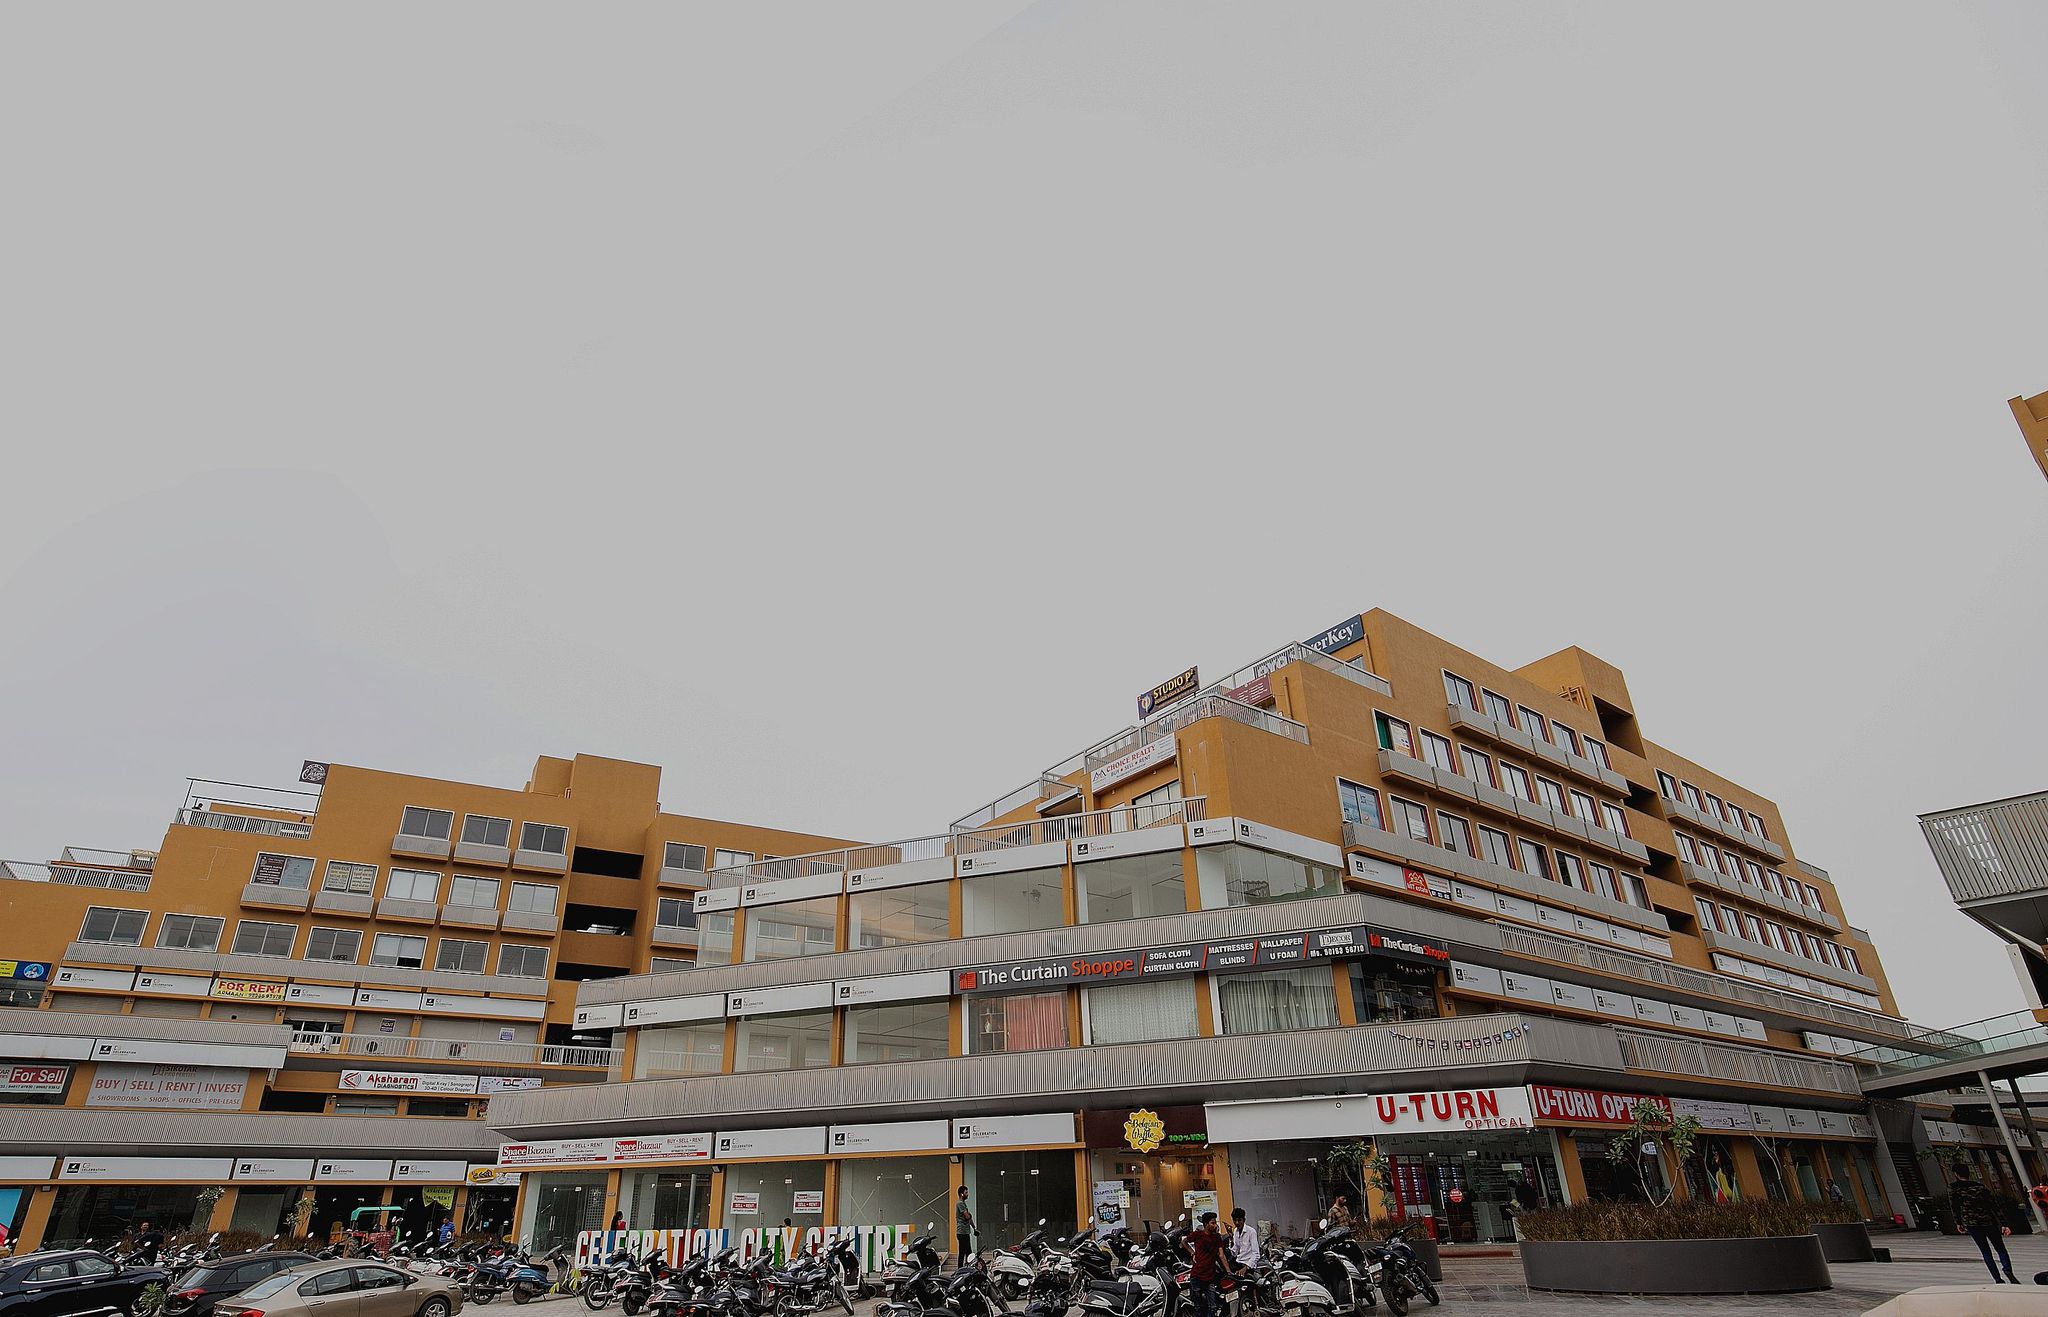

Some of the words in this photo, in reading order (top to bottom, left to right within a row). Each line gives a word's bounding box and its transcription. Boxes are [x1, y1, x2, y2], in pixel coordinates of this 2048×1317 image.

[1153, 674, 1184, 699] STUDIO
[1106, 758, 1131, 773] CHOICE
[1131, 745, 1156, 762] REALTY
[1208, 942, 1254, 954] MATTRESSES
[1260, 937, 1303, 949] WALLPAPER
[1381, 936, 1397, 949] The
[1397, 940, 1424, 955] Curtain
[1149, 952, 1168, 961] SOFA
[1169, 949, 1191, 959] CLOTH
[1220, 956, 1246, 966] BLINDS
[1270, 952, 1276, 961] U
[1277, 950, 1298, 960] FOAM
[979, 970, 1007, 985] The
[1010, 963, 1068, 982] Curtain
[1071, 958, 1134, 979] Shoppe
[1144, 962, 1175, 973] CURTAIN
[1176, 960, 1199, 970] CLOTH
[218, 980, 245, 991] FOR
[248, 983, 284, 994] RENT
[11, 1068, 36, 1082] For
[38, 1069, 64, 1083] Sell
[367, 1073, 418, 1090] Aksharam
[95, 1079, 121, 1089] BUY
[129, 1080, 155, 1090] SELL
[165, 1082, 196, 1092] RENT
[204, 1082, 243, 1093] INVEST
[1376, 1090, 1499, 1124] U-TURN
[1536, 1088, 1599, 1118] U-TURN
[1128, 1118, 1159, 1130] Belgian
[1464, 1117, 1527, 1129] OPTICAL
[1132, 1127, 1155, 1145] Waffle
[1168, 1134, 1190, 1142] 100%
[1190, 1133, 1207, 1141] VEG
[502, 1146, 527, 1160] Space
[527, 1145, 556, 1155] Bazaar
[615, 1141, 637, 1155] Space
[637, 1140, 663, 1150] Bazaar
[576, 1228, 731, 1269] CELEBRATION
[740, 1227, 800, 1268] CITY
[806, 1225, 912, 1273] CENTRE
